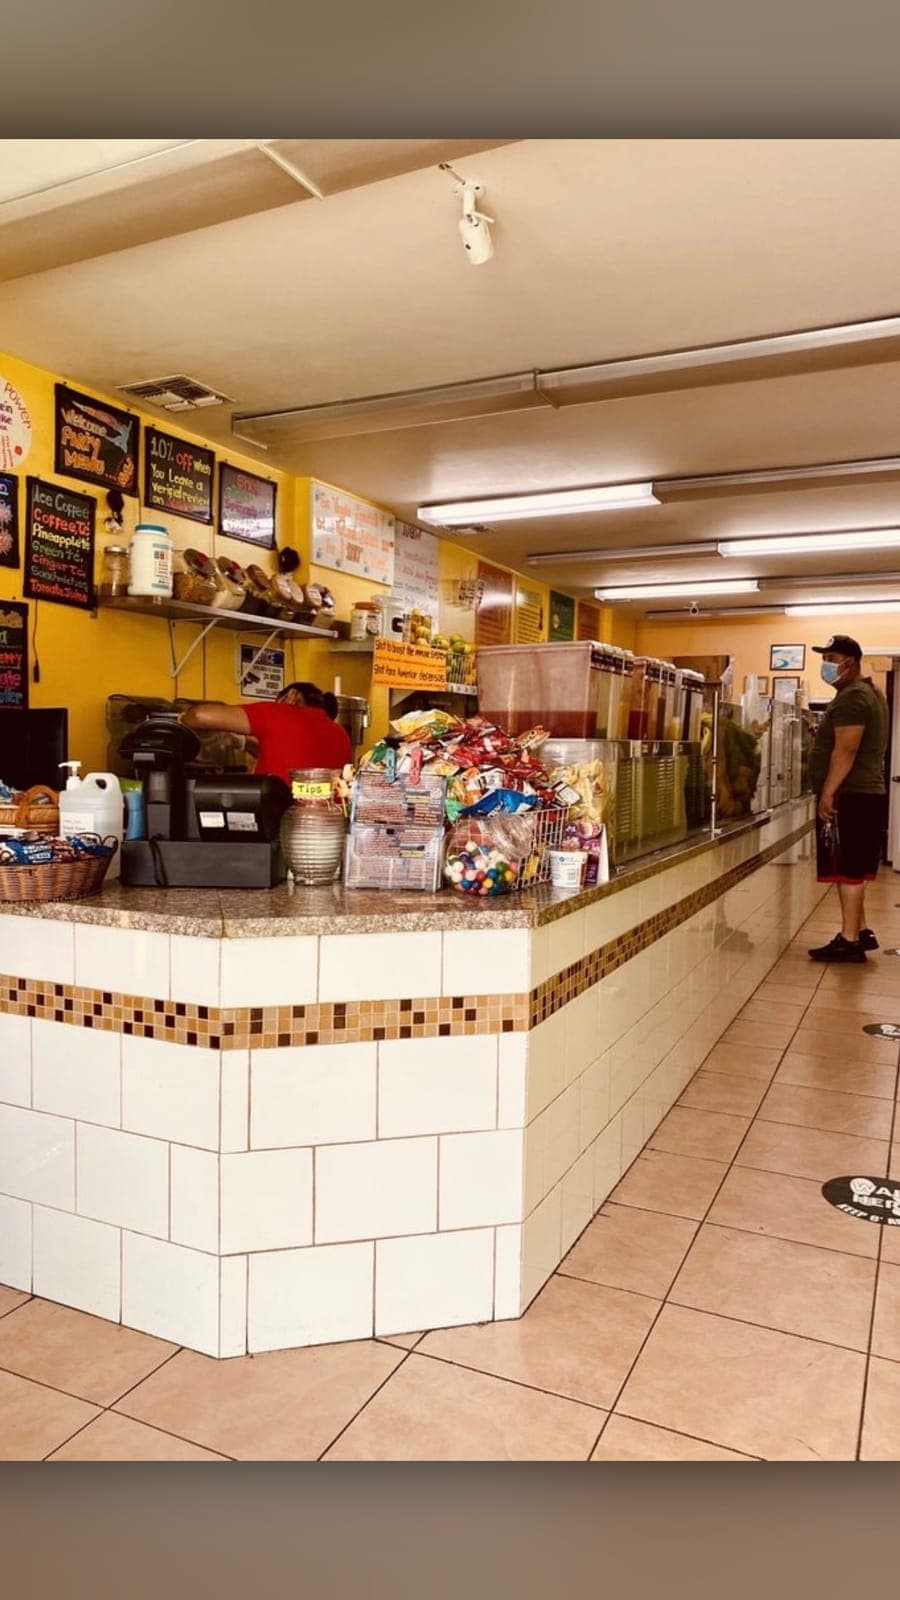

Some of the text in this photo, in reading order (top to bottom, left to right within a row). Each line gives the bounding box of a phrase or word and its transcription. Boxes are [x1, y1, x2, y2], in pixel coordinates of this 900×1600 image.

[150, 437, 175, 461] 10%
[151, 463, 165, 479] You
[195, 482, 203, 492] a
[297, 784, 322, 794] Tips
